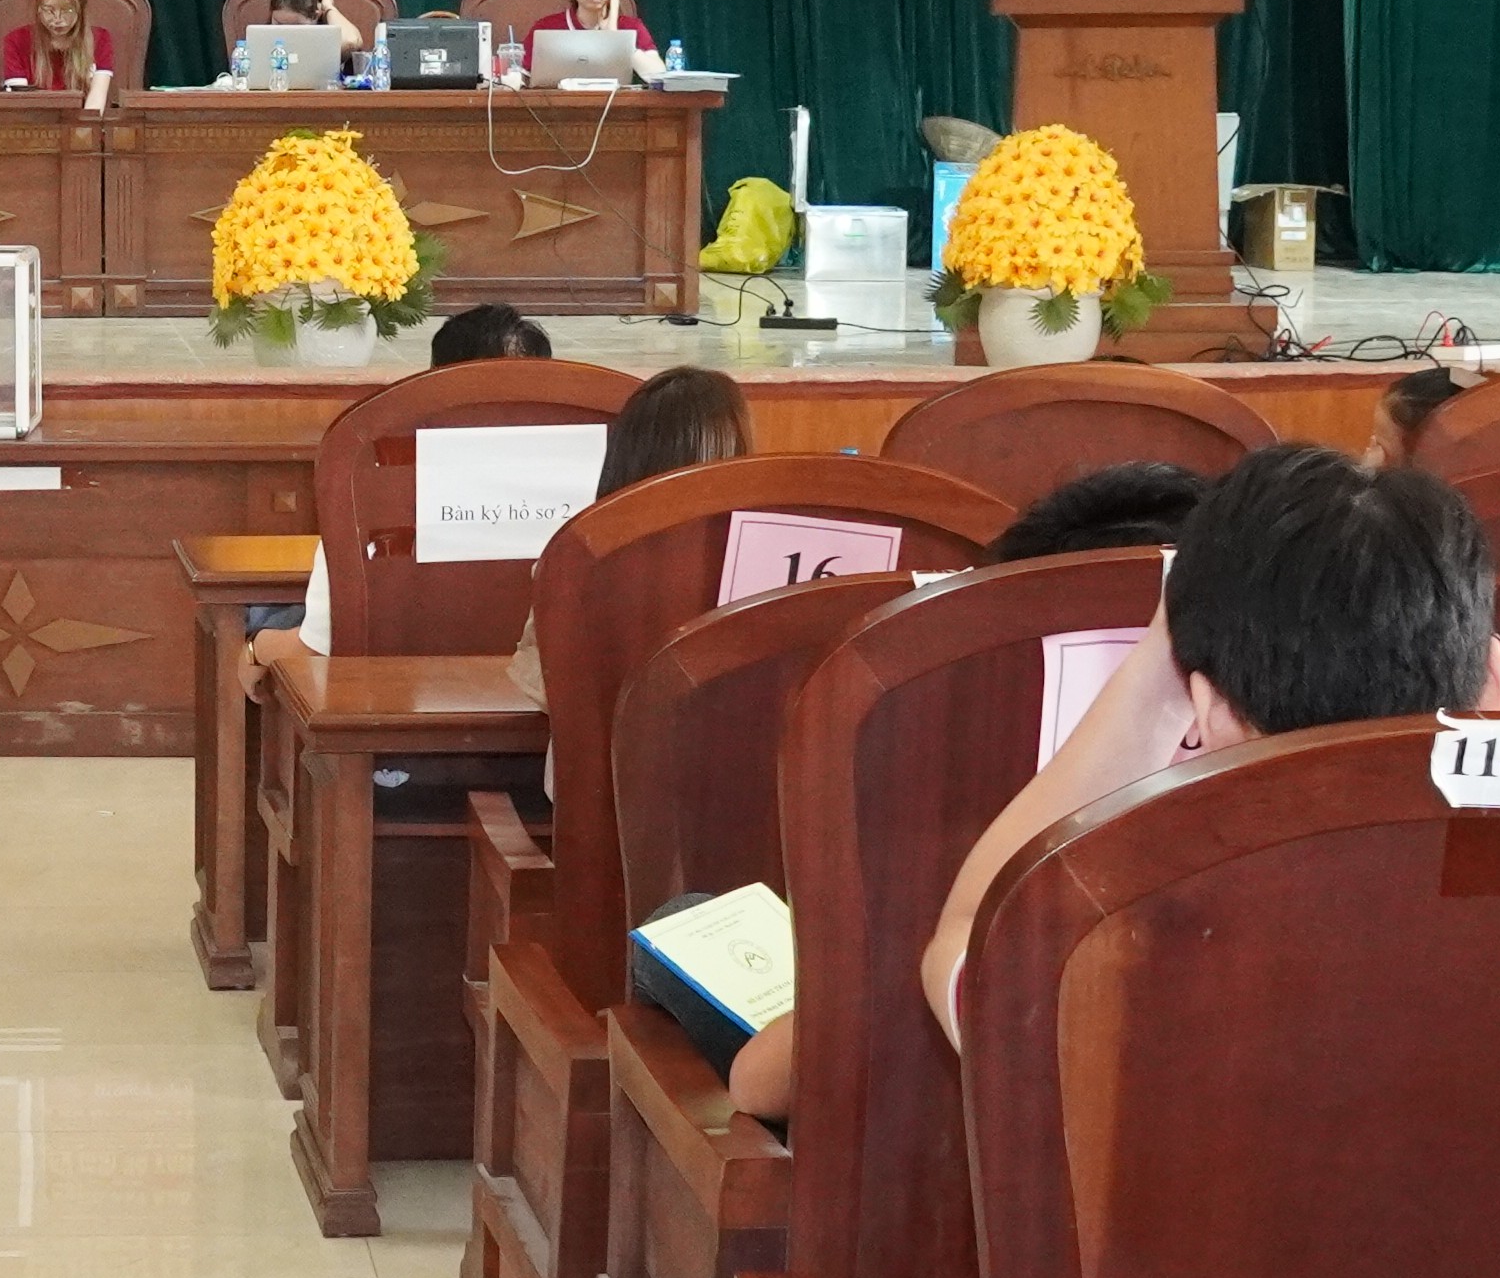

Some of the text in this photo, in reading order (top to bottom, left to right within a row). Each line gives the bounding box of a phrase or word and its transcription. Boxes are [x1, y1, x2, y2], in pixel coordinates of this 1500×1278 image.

[441, 500, 570, 524] Bàn ký hồ sơ 2
